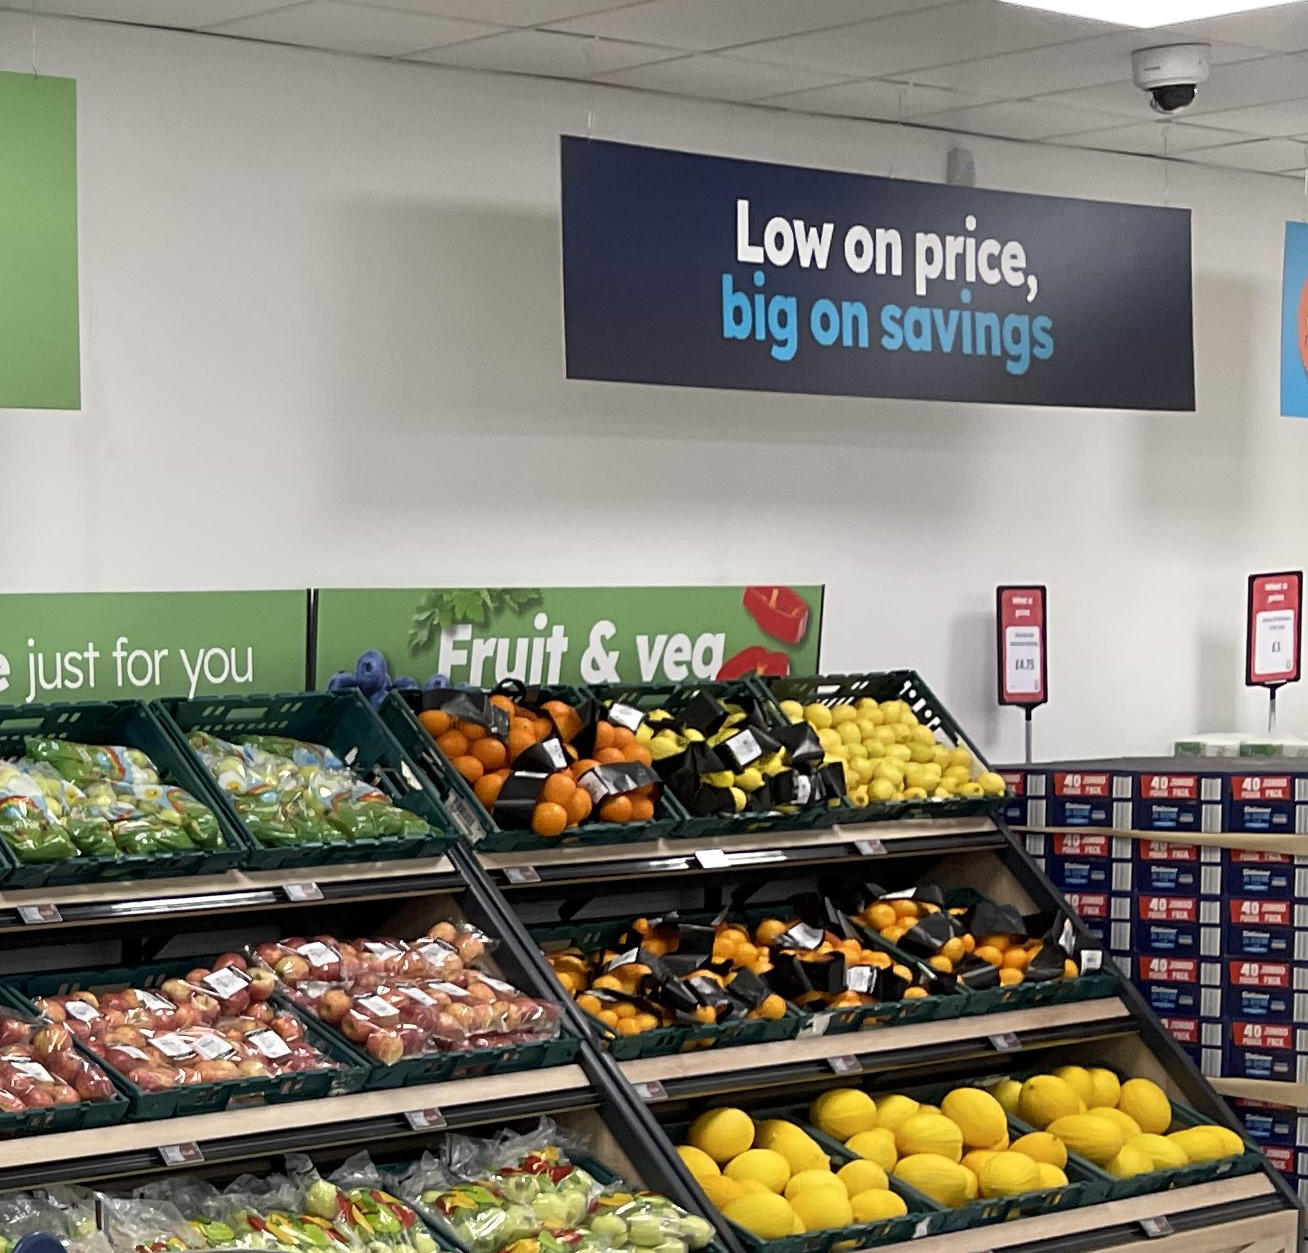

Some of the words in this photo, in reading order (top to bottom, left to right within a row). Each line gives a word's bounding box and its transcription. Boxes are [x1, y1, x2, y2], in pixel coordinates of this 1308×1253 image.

[736, 198, 835, 270] Low
[844, 225, 903, 277] on
[915, 214, 1039, 303] price,
[722, 272, 798, 361] big
[810, 299, 869, 348] on
[880, 287, 1055, 375] savings
[438, 612, 569, 687] Fruit
[580, 620, 621, 684] &
[25, 638, 100, 704] just
[111, 636, 169, 687] for
[179, 646, 253, 700] you
[1064, 774, 1081, 787] 40
[1151, 776, 1168, 789] 40
[1242, 777, 1260, 791] 40
[1063, 834, 1080, 847] 40
[1149, 898, 1167, 911] 40
[1241, 901, 1259, 914] 40
[1150, 959, 1167, 971] 40
[1240, 963, 1259, 976] 40
[1244, 1024, 1262, 1038] 40
